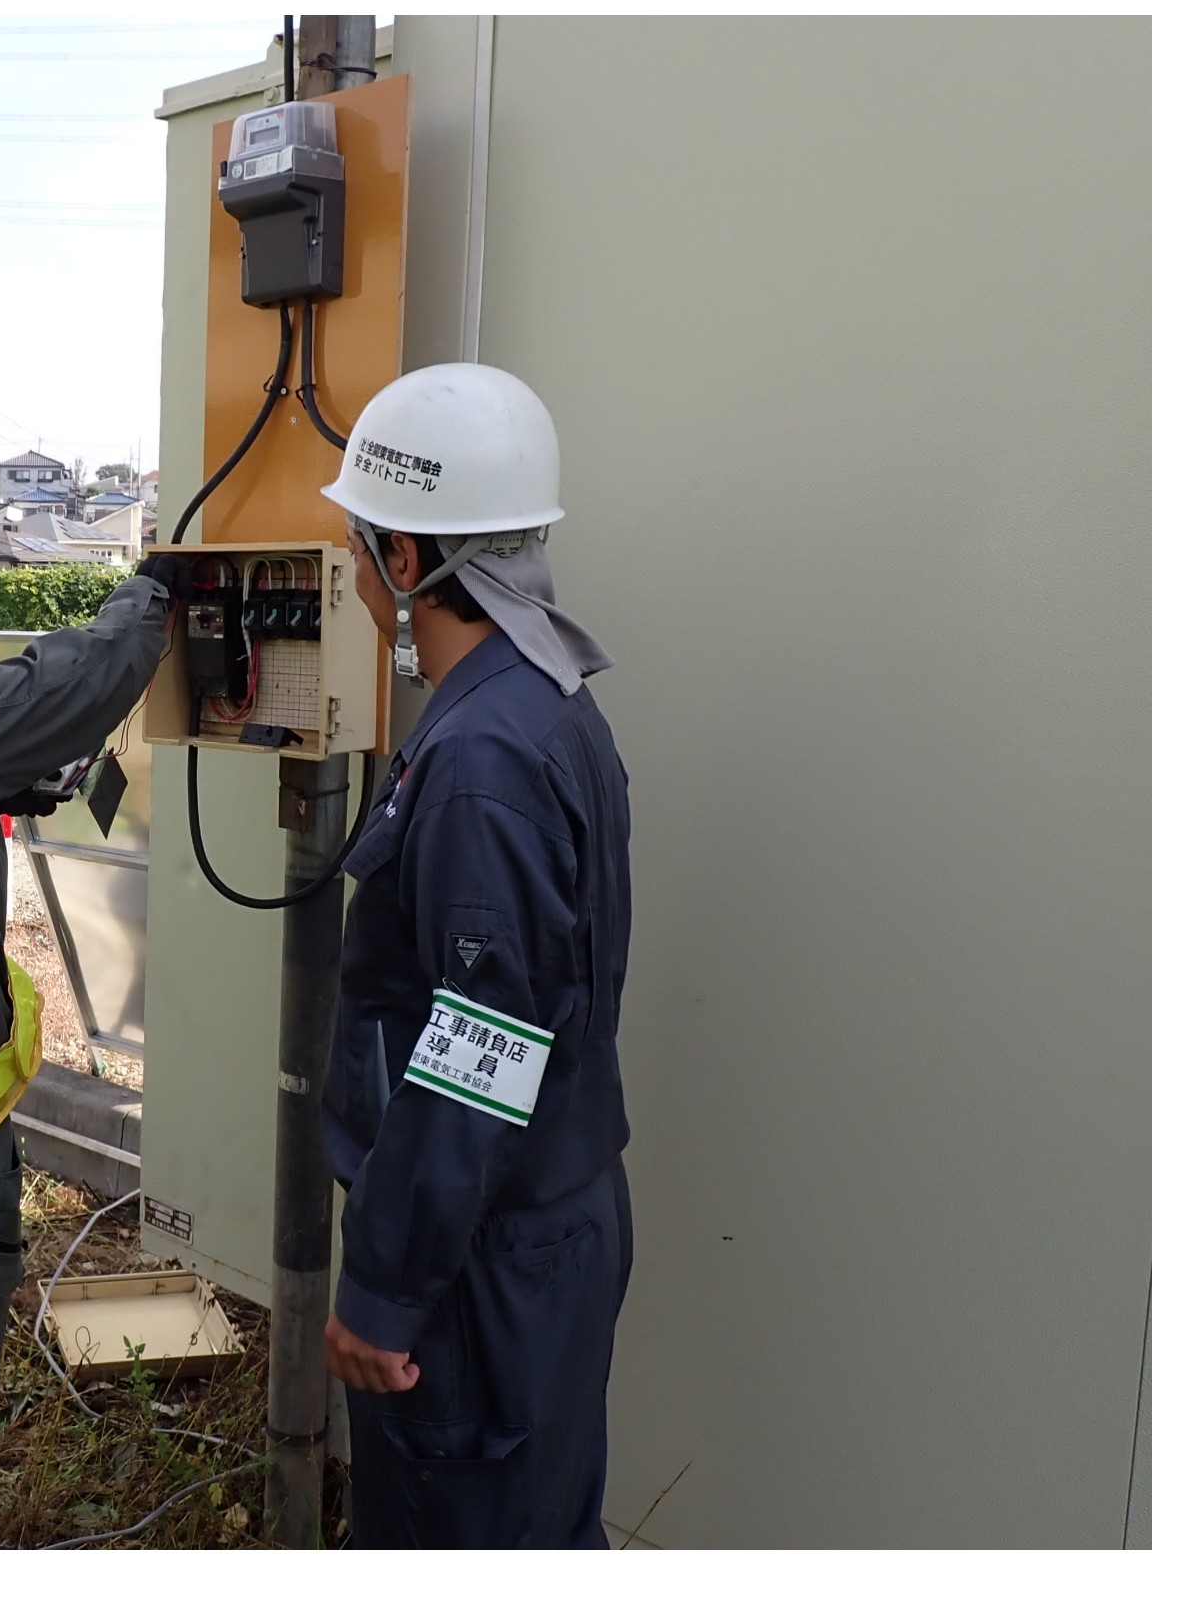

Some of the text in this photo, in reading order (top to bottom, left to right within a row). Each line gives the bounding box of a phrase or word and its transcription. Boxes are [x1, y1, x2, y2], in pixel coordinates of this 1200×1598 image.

[354, 454, 436, 492] 安全パトロール
[457, 937, 482, 950] XEBEC
[426, 1031, 501, 1079] 導 員
[429, 1008, 529, 1064] 工事請負店
